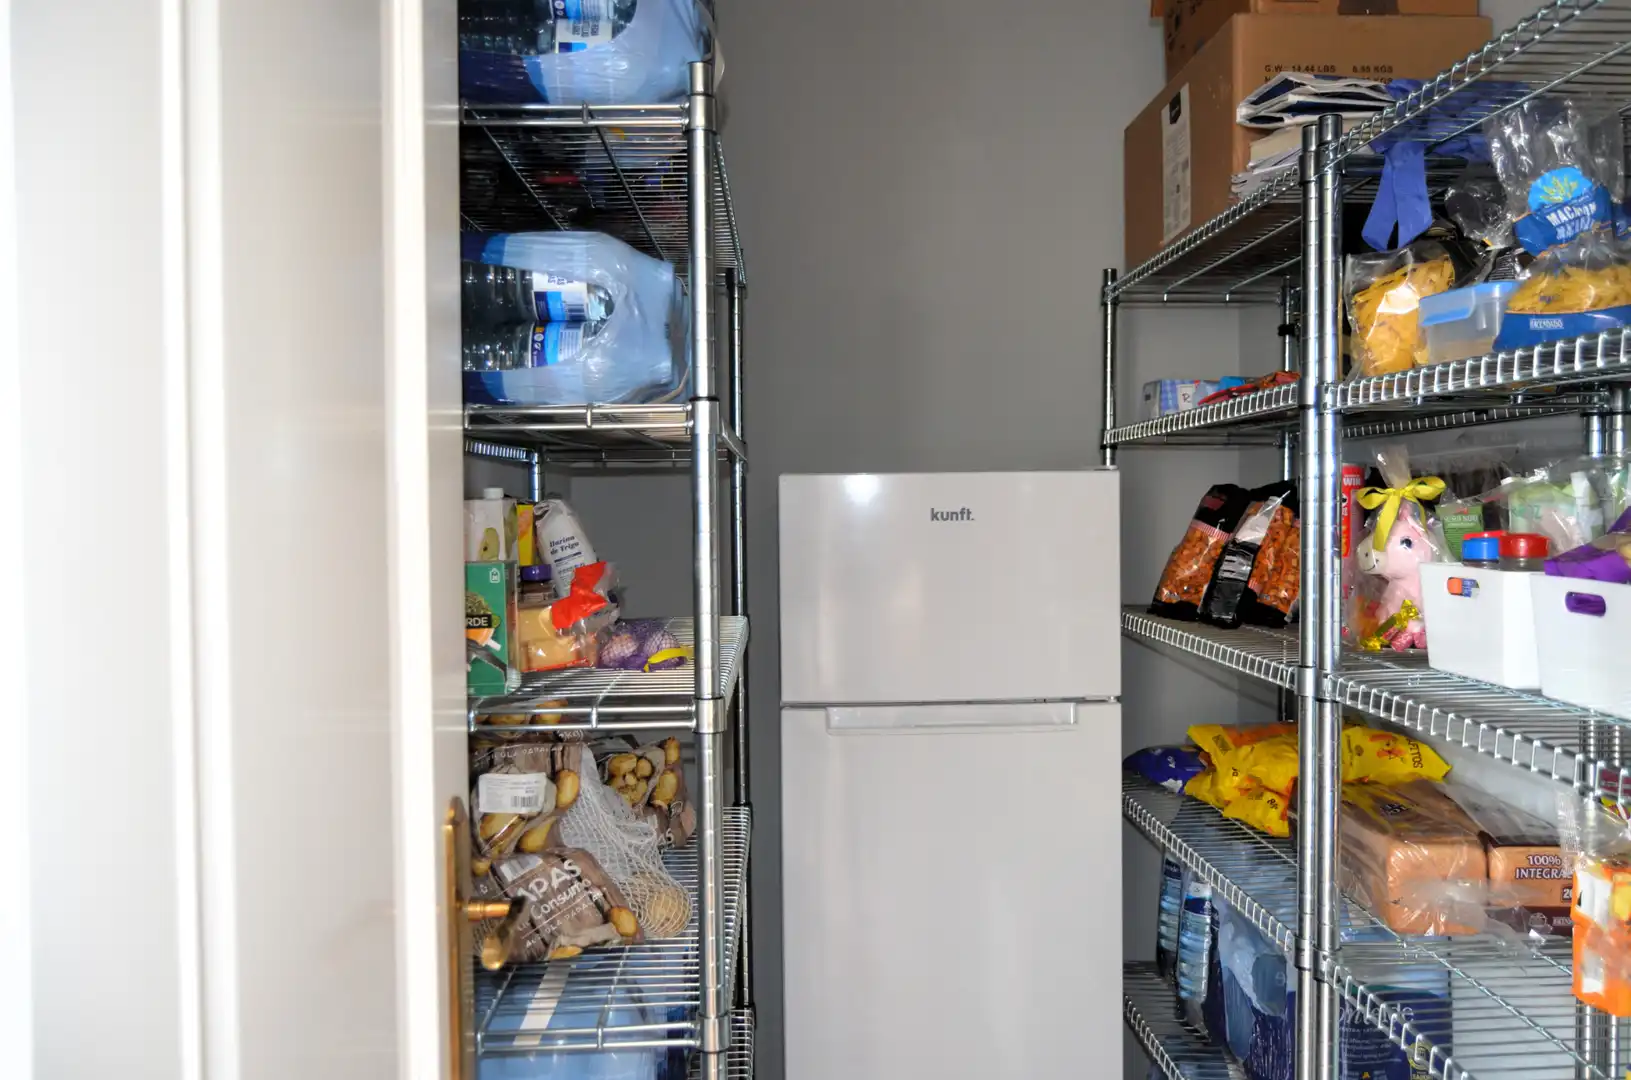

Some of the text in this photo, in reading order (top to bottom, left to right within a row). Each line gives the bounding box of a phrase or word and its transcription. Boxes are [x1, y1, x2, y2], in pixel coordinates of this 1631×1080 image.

[1317, 64, 1337, 73] LBS
[1373, 64, 1394, 73] KGS
[1526, 854, 1562, 866] 100%
[1515, 867, 1573, 880] INTEGRA
[530, 878, 592, 920] Consumo
